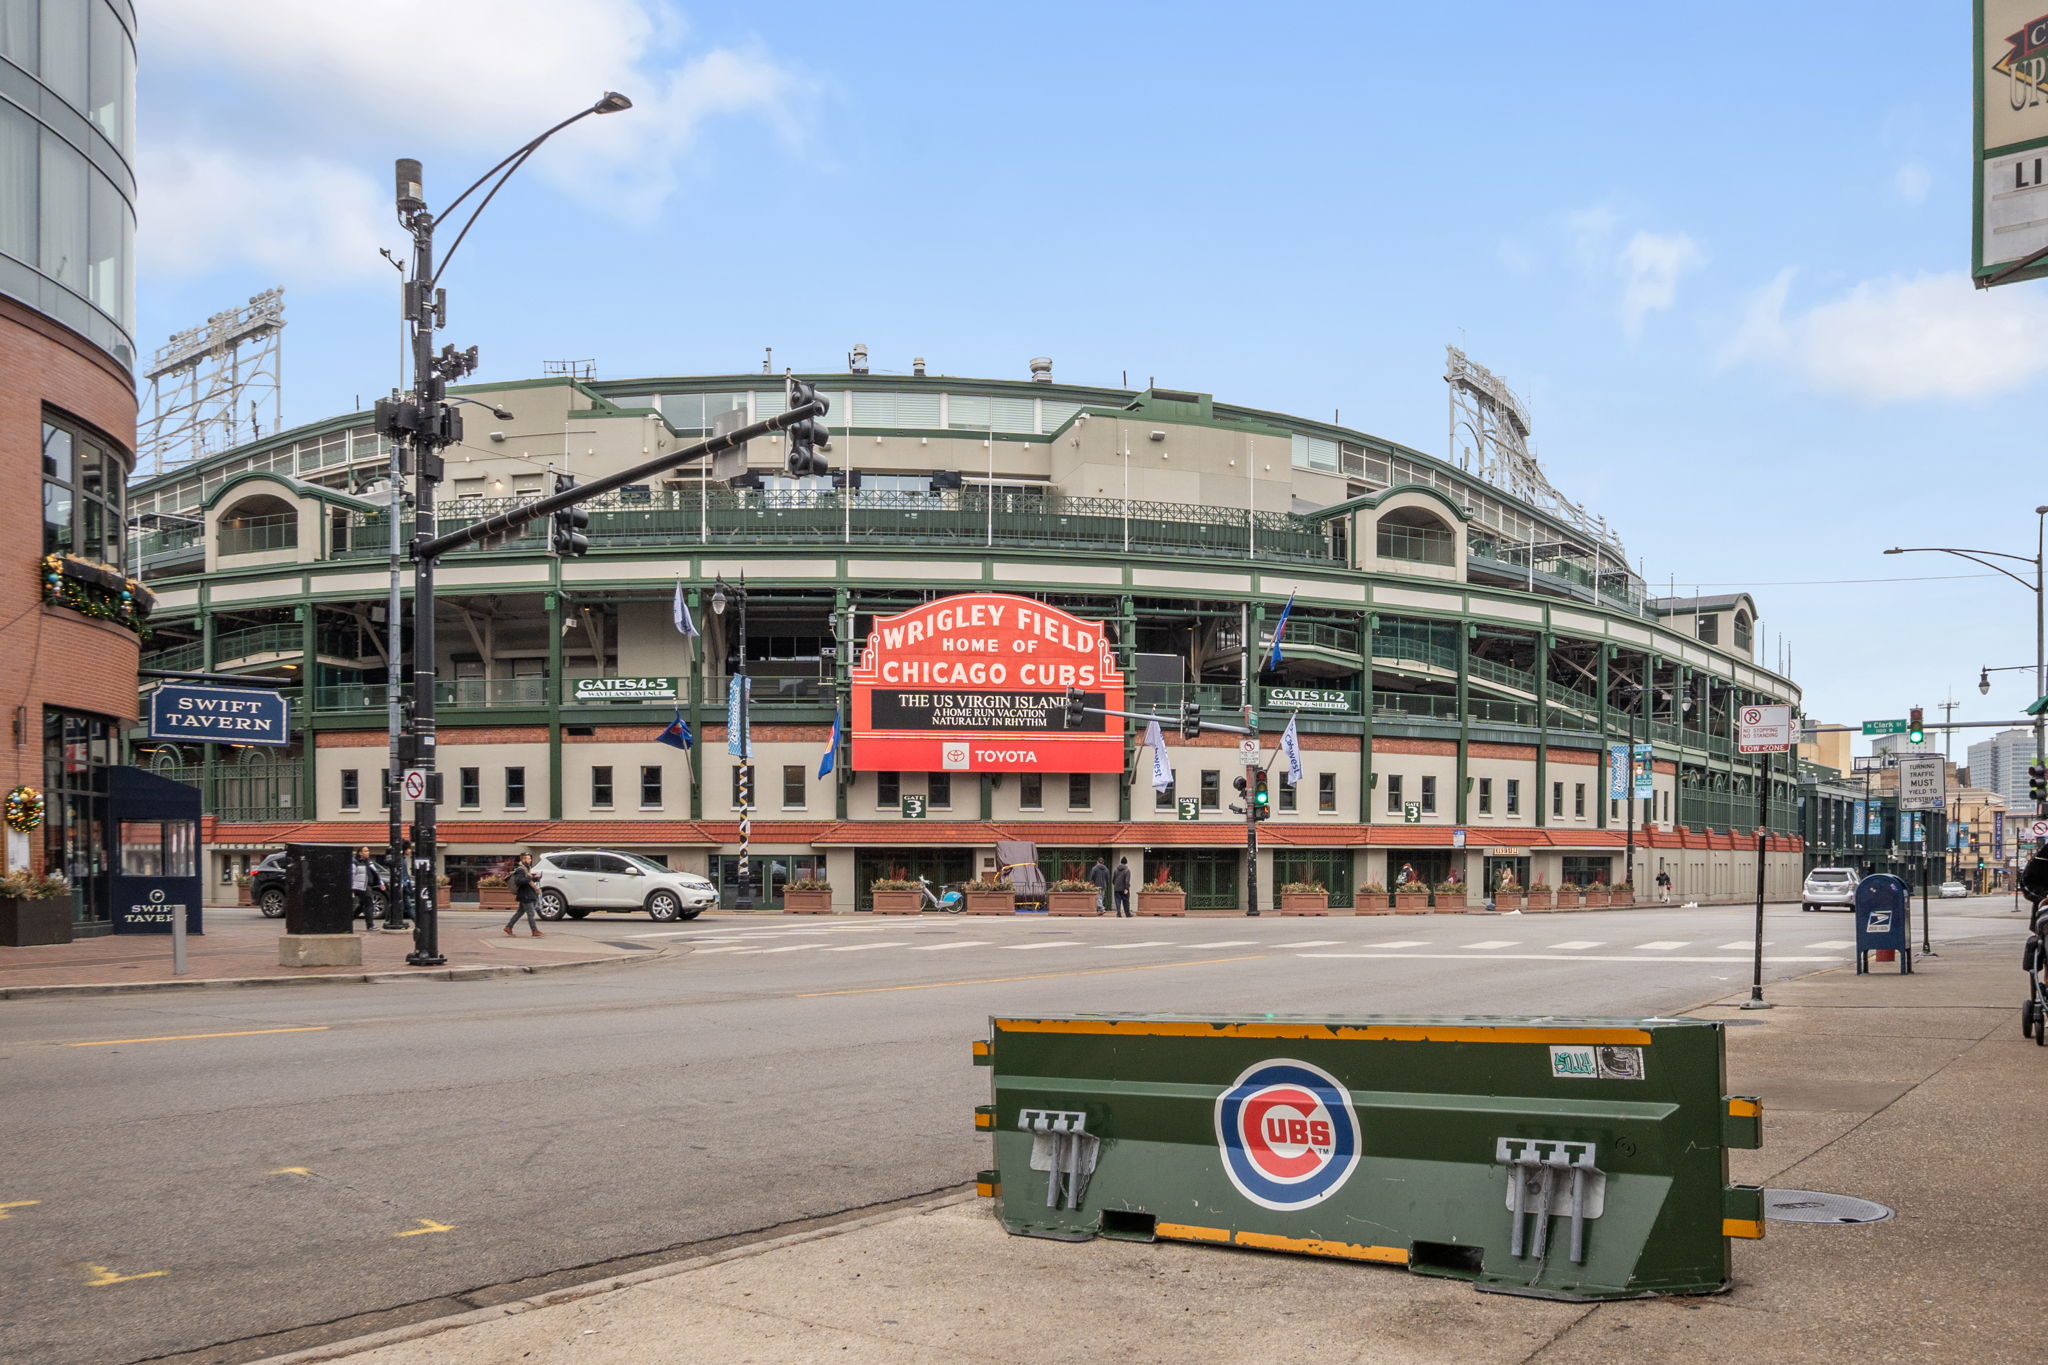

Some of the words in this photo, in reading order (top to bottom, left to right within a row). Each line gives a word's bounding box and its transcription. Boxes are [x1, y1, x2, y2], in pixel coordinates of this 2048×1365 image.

[2031, 22, 2048, 46] C
[2010, 55, 2048, 111] UP
[883, 604, 1005, 650] WRIGLEY
[1017, 607, 1094, 653] FIELD
[942, 638, 999, 652] HOME
[1012, 639, 1038, 653] OF
[882, 661, 1007, 684] CHICAGO
[1020, 663, 1095, 686] CUBS
[578, 679, 637, 690] GATES
[1271, 688, 1319, 700] GATES
[178, 697, 262, 714] SWIFT
[899, 694, 930, 707] THE
[933, 695, 953, 708] US
[957, 695, 1011, 709] VIRGIN
[1014, 696, 1071, 709] ISLAND
[933, 708, 940, 716] A
[942, 708, 972, 717] HOME
[974, 708, 995, 717] RUN
[997, 709, 1046, 718] VACATION
[166, 713, 272, 731] TAVERN
[932, 716, 990, 726] NATURALLY
[992, 717, 1003, 726] IN
[1004, 717, 1047, 727] RHYTHM
[1874, 721, 1894, 729] Clark
[975, 750, 1037, 763] TOYOTA
[1910, 779, 1934, 787] MUST
[906, 800, 922, 813] 3
[1182, 802, 1196, 815] 3
[1407, 806, 1418, 818] 3
[131, 905, 173, 913] SWIF
